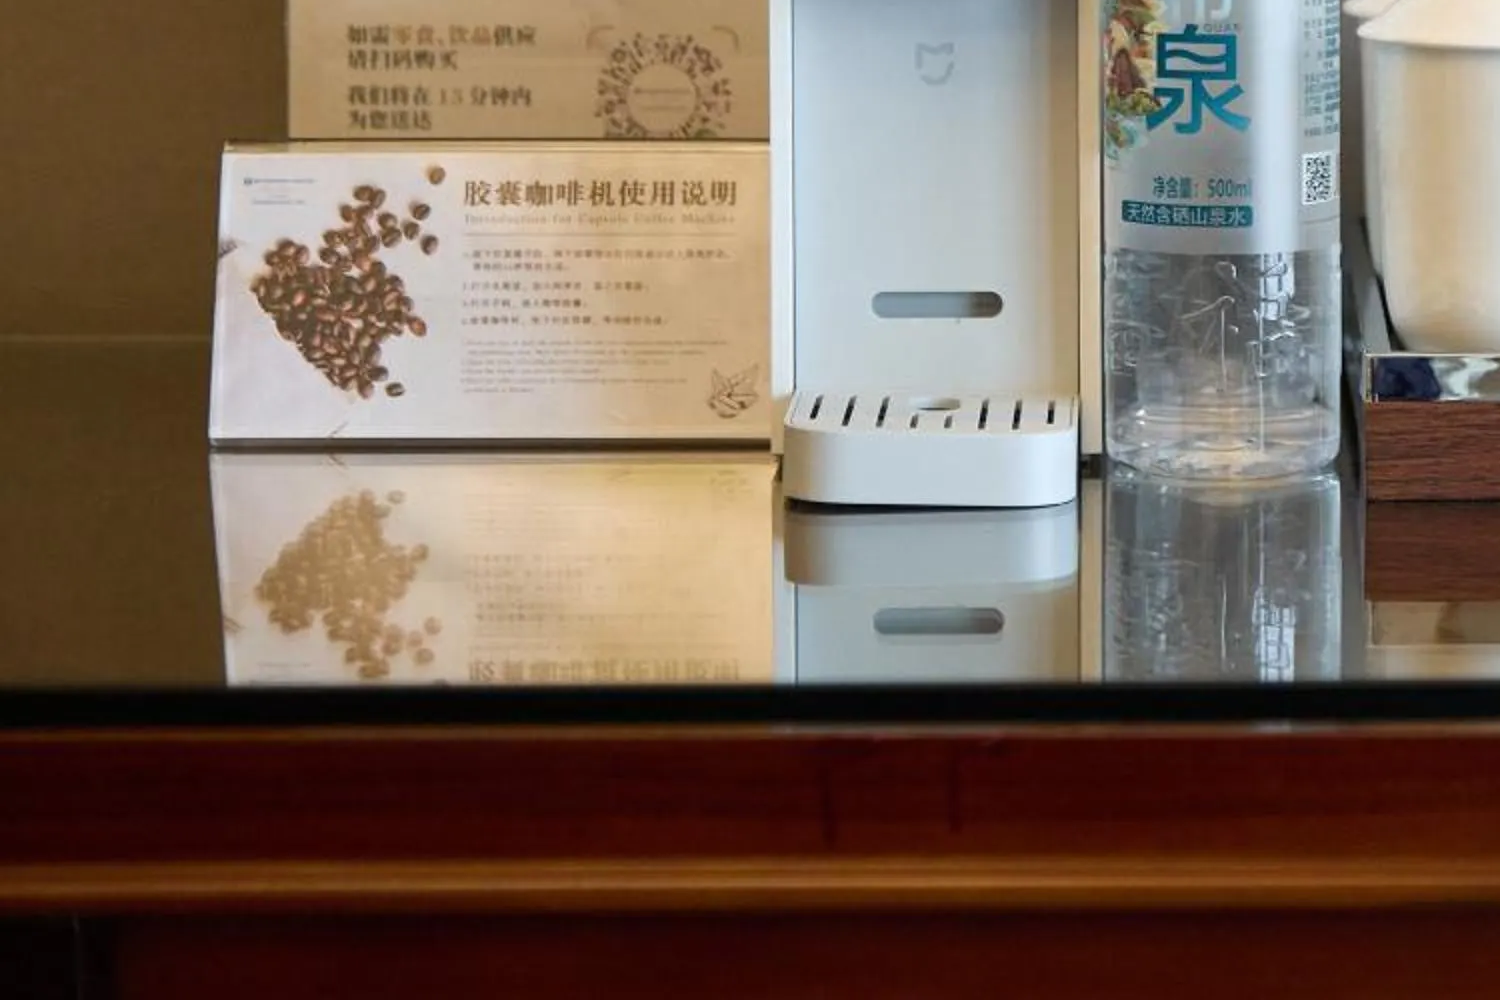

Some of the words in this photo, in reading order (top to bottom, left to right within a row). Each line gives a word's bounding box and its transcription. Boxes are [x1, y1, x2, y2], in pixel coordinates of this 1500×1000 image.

[463, 180, 738, 207] 胶囊咖啡机使用说明
[1126, 202, 1248, 227] 天然含硒山泉水
